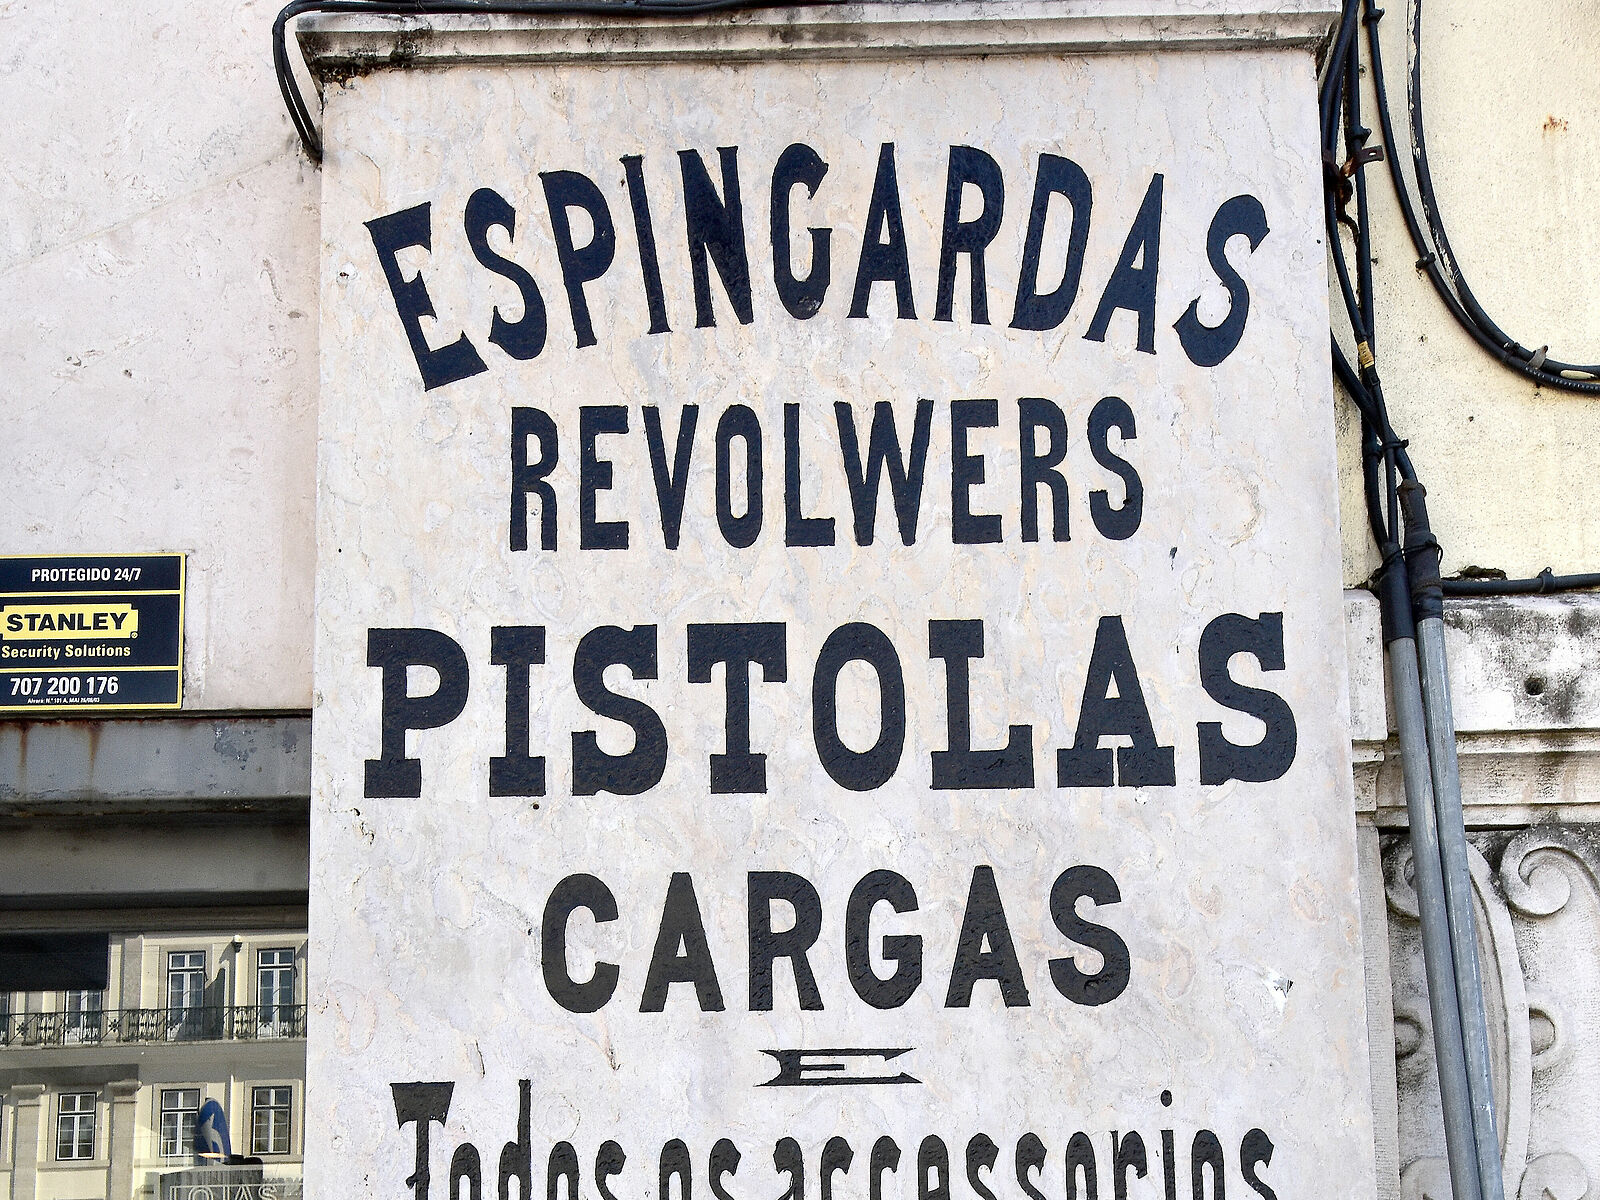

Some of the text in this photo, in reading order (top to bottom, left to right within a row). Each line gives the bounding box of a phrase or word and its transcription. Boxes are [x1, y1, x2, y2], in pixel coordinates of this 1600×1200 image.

[362, 142, 1270, 391] ESPINGARDAS
[510, 397, 1143, 552] REVOLWERS
[31, 567, 142, 582] PROTEGIDO 24/7
[6, 612, 129, 632] STANLEY
[1, 644, 131, 660] Security Solutions
[10, 676, 119, 696] 707 200 176
[364, 611, 1297, 798] PISTOLAS
[541, 865, 1131, 1013] CARGAS
[753, 1048, 923, 1087] E
